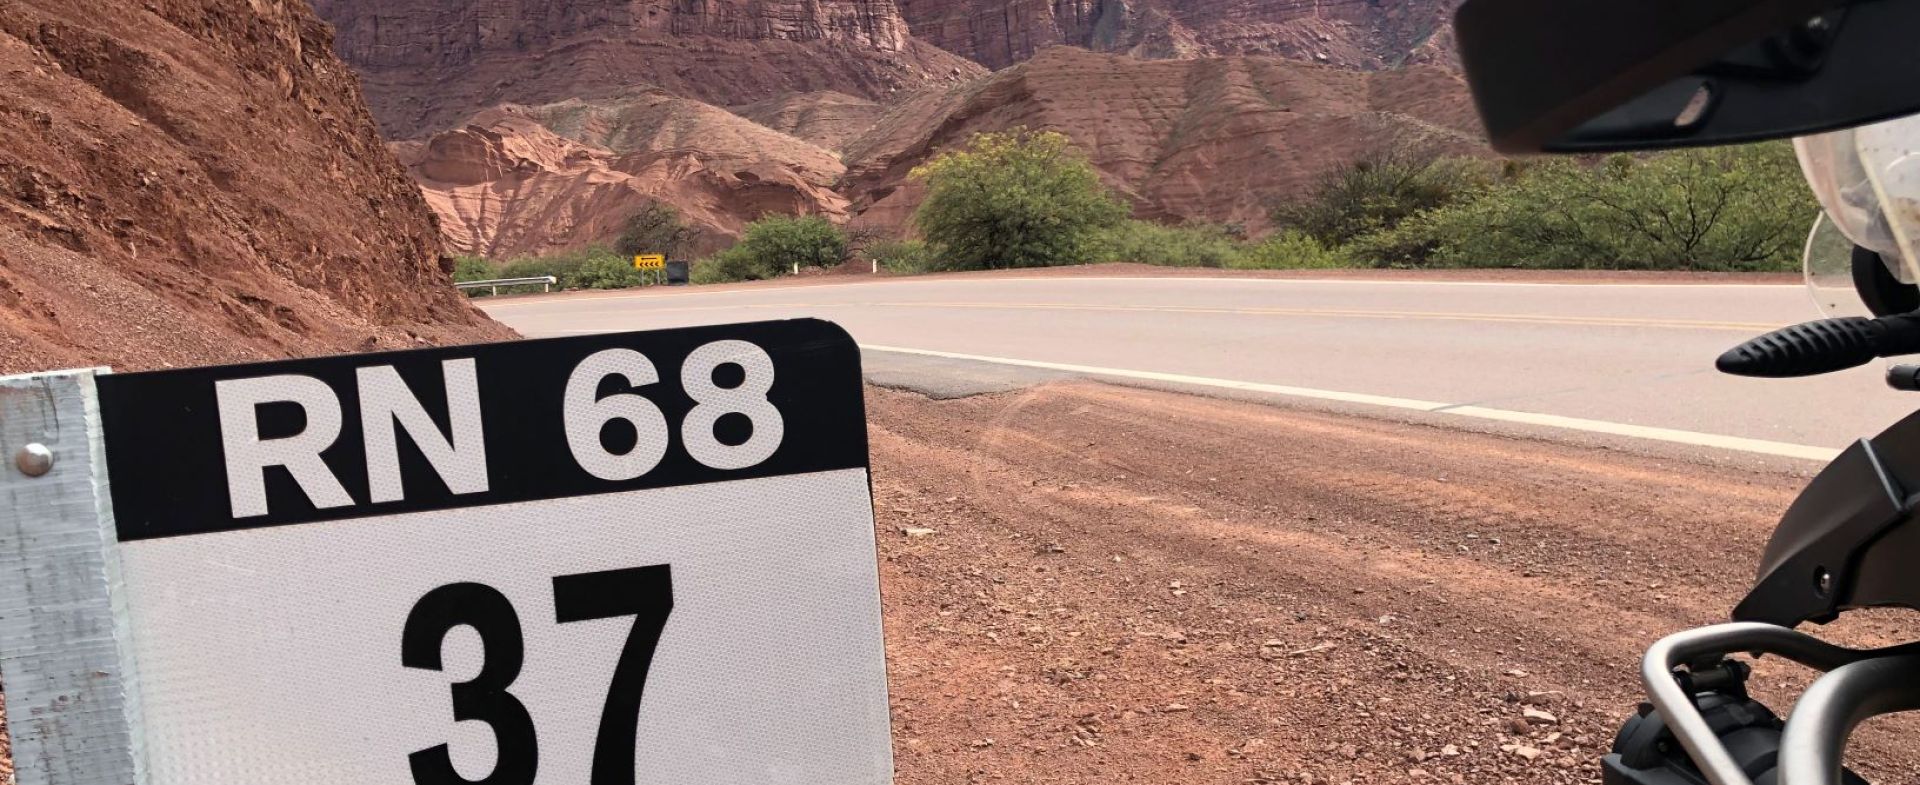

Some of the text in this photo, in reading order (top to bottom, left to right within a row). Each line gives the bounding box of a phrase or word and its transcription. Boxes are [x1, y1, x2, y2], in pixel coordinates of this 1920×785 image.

[216, 339, 784, 518] RN 68
[401, 564, 673, 785] 37
